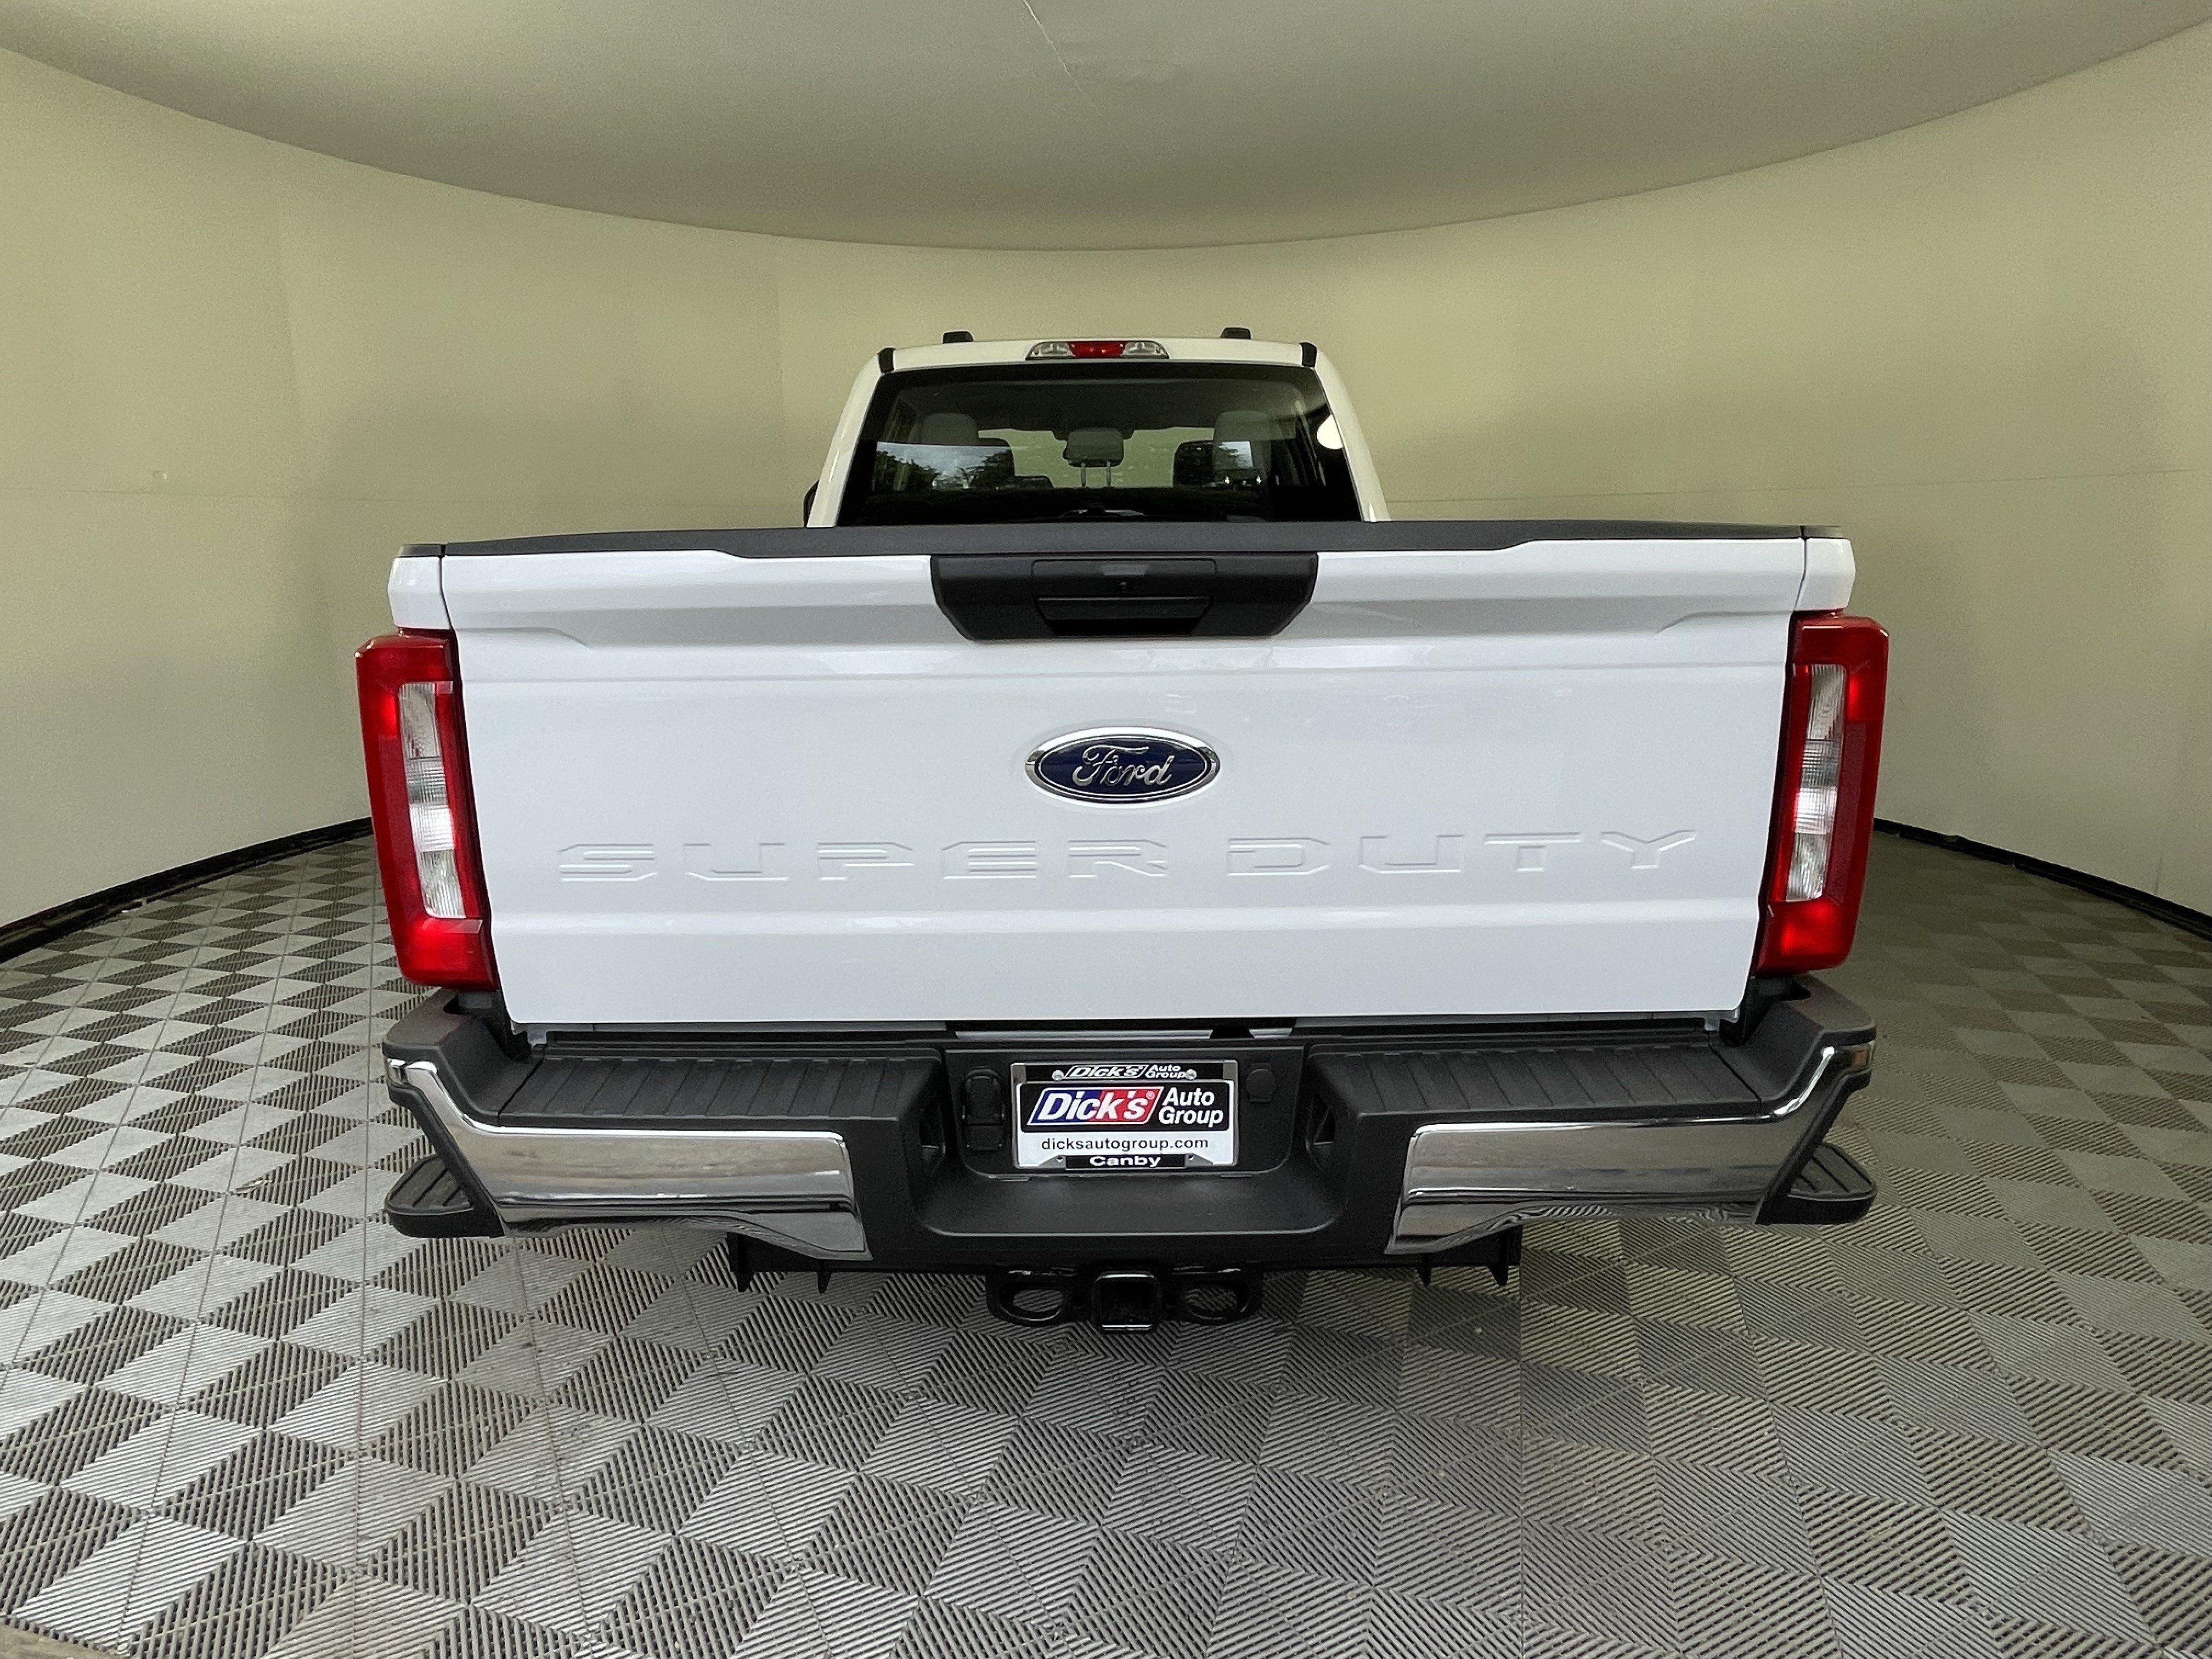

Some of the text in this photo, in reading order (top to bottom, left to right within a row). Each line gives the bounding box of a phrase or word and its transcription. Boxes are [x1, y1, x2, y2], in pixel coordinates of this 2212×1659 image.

[1072, 744, 1175, 787] Ford
[556, 829, 1697, 882] SUPER DUTY
[1144, 1070, 1187, 1080] Group
[1149, 1064, 1182, 1073] Auto
[1161, 1087, 1215, 1107] Auto
[1158, 1108, 1224, 1128] Group
[1041, 1138, 1209, 1152] dicksautogroup.com
[1089, 1155, 1161, 1168] Canby
